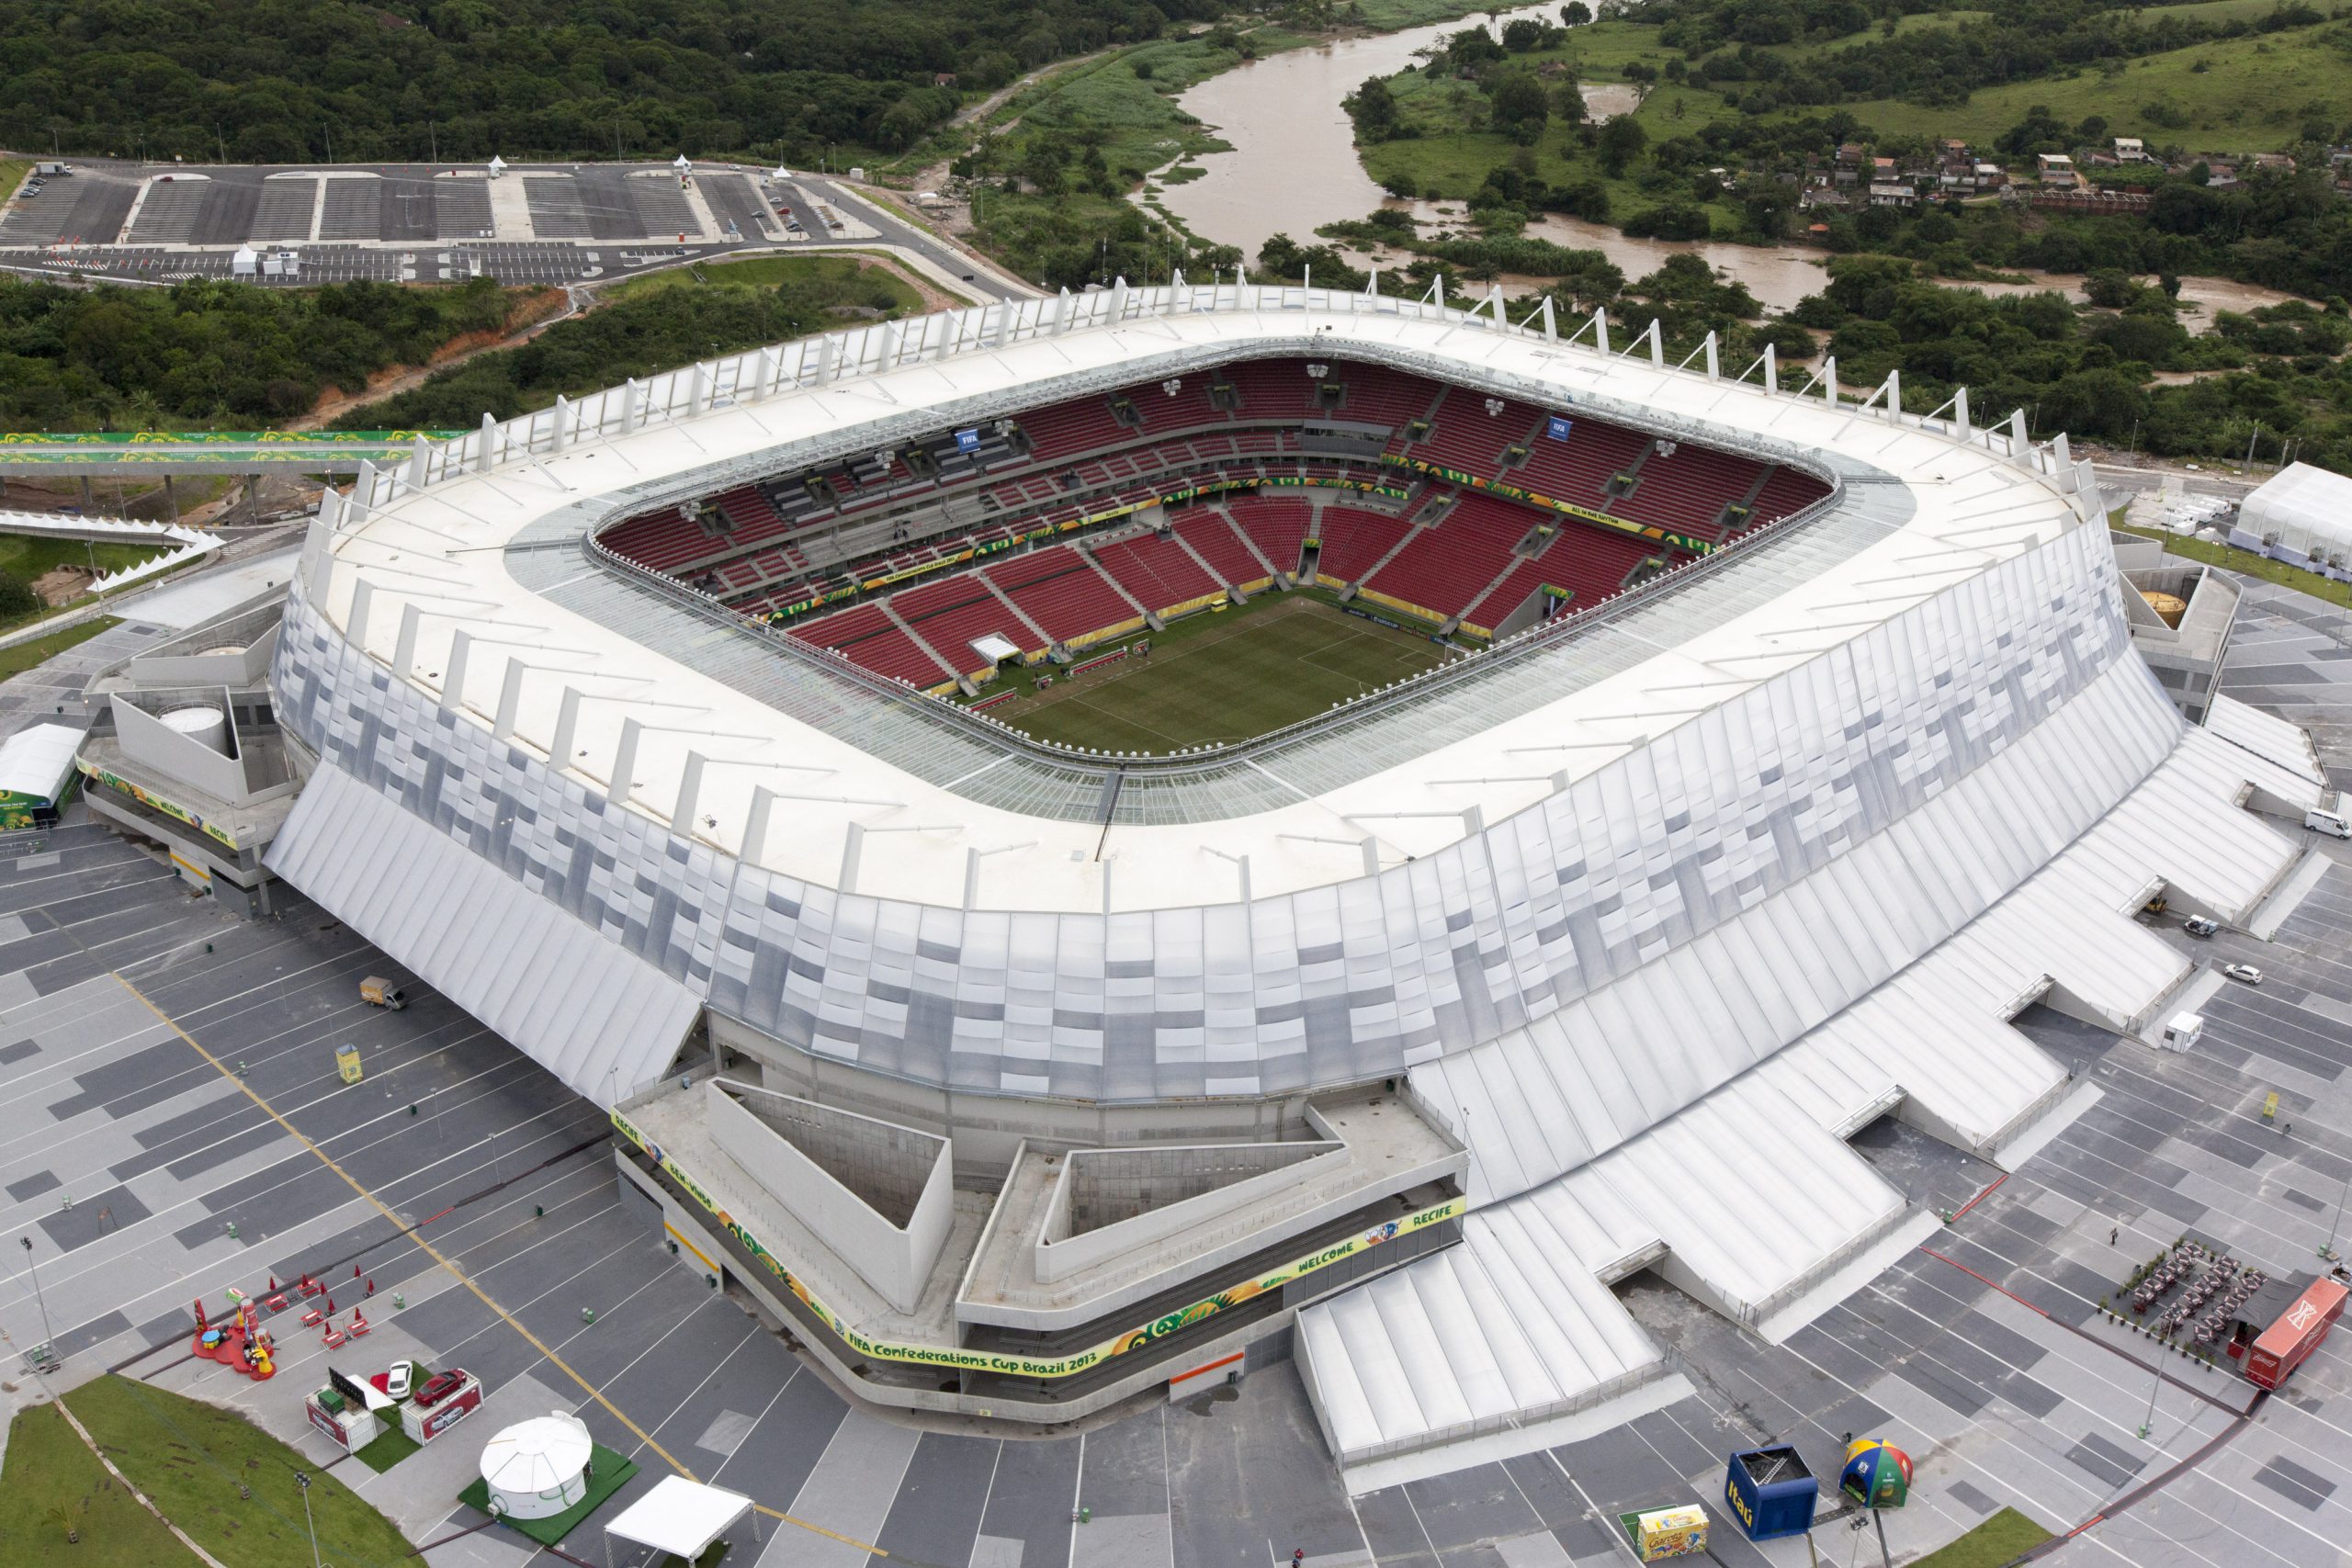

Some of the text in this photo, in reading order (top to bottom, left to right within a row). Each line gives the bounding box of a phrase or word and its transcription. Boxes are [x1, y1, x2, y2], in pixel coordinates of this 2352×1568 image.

[962, 434, 978, 445] FIFA
[616, 1114, 712, 1208] RECIFE BEM-VINDO
[1298, 1204, 1453, 1273] WELCOME RECIFE
[849, 1332, 1097, 1374] FIFA Confederations Cup Brazil 2013
[1728, 1480, 1753, 1529] Itaú
